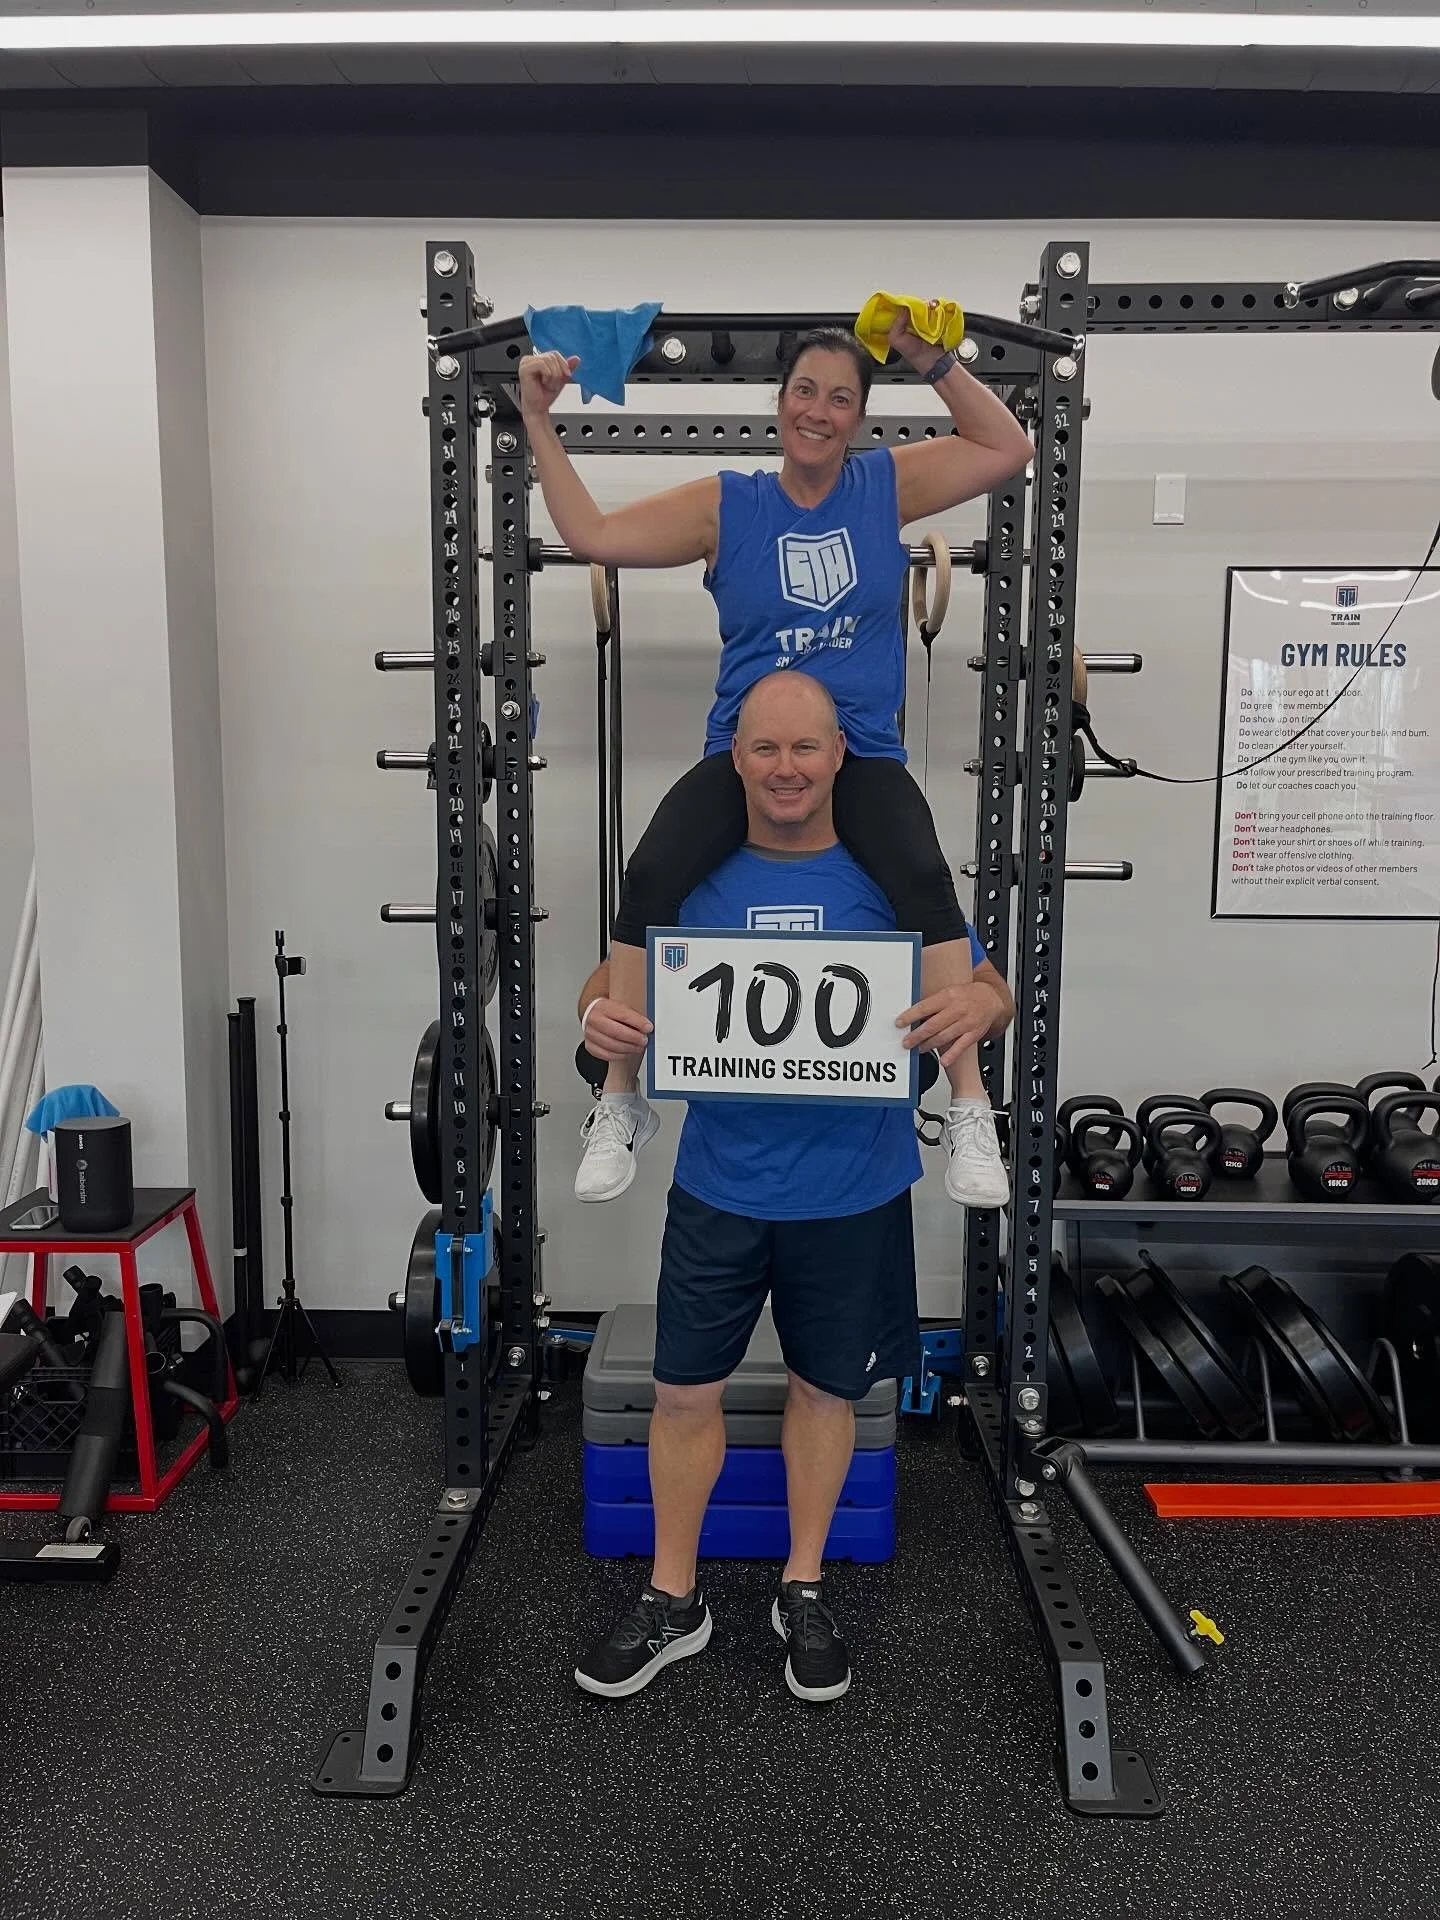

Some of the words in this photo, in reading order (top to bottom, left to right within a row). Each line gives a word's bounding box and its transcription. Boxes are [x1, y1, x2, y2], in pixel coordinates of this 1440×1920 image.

[442, 412, 456, 425] 32
[1054, 414, 1070, 428] 32
[442, 445, 455, 459] 31
[1053, 446, 1066, 460] 31
[444, 511, 458, 525] 29
[1051, 514, 1065, 527] 29
[444, 543, 458, 556] 28
[1050, 546, 1066, 560] 28
[446, 609, 460, 624] 26
[1048, 613, 1065, 626] 26
[776, 616, 862, 652] TRAIN
[448, 640, 460, 655] 25
[1048, 644, 1062, 658] 25
[1281, 643, 1328, 667] GYM
[1336, 643, 1407, 667] RULES
[1241, 688, 1252, 696] Do
[1298, 690, 1314, 698] ego
[448, 704, 462, 719] 23
[1240, 702, 1252, 710] Do
[1254, 703, 1274, 711] gree
[1044, 708, 1058, 722] 23
[448, 736, 462, 750] 22
[1042, 741, 1060, 754] 22
[1276, 770, 1295, 778] your
[1298, 768, 1342, 778] prescribed
[1344, 769, 1374, 778] training
[1376, 770, 1414, 779] program.
[450, 798, 464, 812] 20
[1041, 803, 1056, 816] 20
[1235, 812, 1256, 820] Don't
[1258, 812, 1280, 821] bring
[1318, 812, 1344, 821] phone
[1366, 812, 1380, 820] the
[1382, 812, 1412, 822] training
[1234, 824, 1256, 832] Don't
[450, 829, 462, 843] 19
[1040, 836, 1052, 850] 19
[1234, 838, 1256, 846] Don't
[1368, 838, 1390, 846] while
[1392, 839, 1424, 848] training.
[1278, 851, 1317, 859] offensive
[1232, 864, 1254, 872] Don't
[1276, 864, 1304, 873] photos
[1316, 864, 1343, 872] videos
[1286, 878, 1315, 886] explicit
[452, 891, 464, 905] 17
[1038, 897, 1050, 911] 17
[450, 921, 464, 935] 16
[1036, 927, 1050, 941] 16
[454, 982, 468, 996] 14
[1035, 990, 1048, 1002] 14
[688, 962, 872, 1048] 100
[453, 1012, 465, 1026] 13
[1034, 1020, 1046, 1032] 13
[668, 1056, 776, 1079] TRAINING
[782, 1059, 897, 1083] SESSIONS
[454, 1072, 465, 1086] 11
[1032, 1080, 1044, 1093] 11
[454, 1102, 466, 1114] 10
[1031, 1110, 1044, 1123] 10
[457, 1160, 465, 1174] 8
[1032, 1170, 1040, 1184] 8
[456, 1190, 464, 1203] 7
[1028, 1200, 1039, 1214] 7
[1028, 1260, 1038, 1272] 5
[1027, 1288, 1037, 1302] 4
[1024, 1346, 1034, 1359] 2
